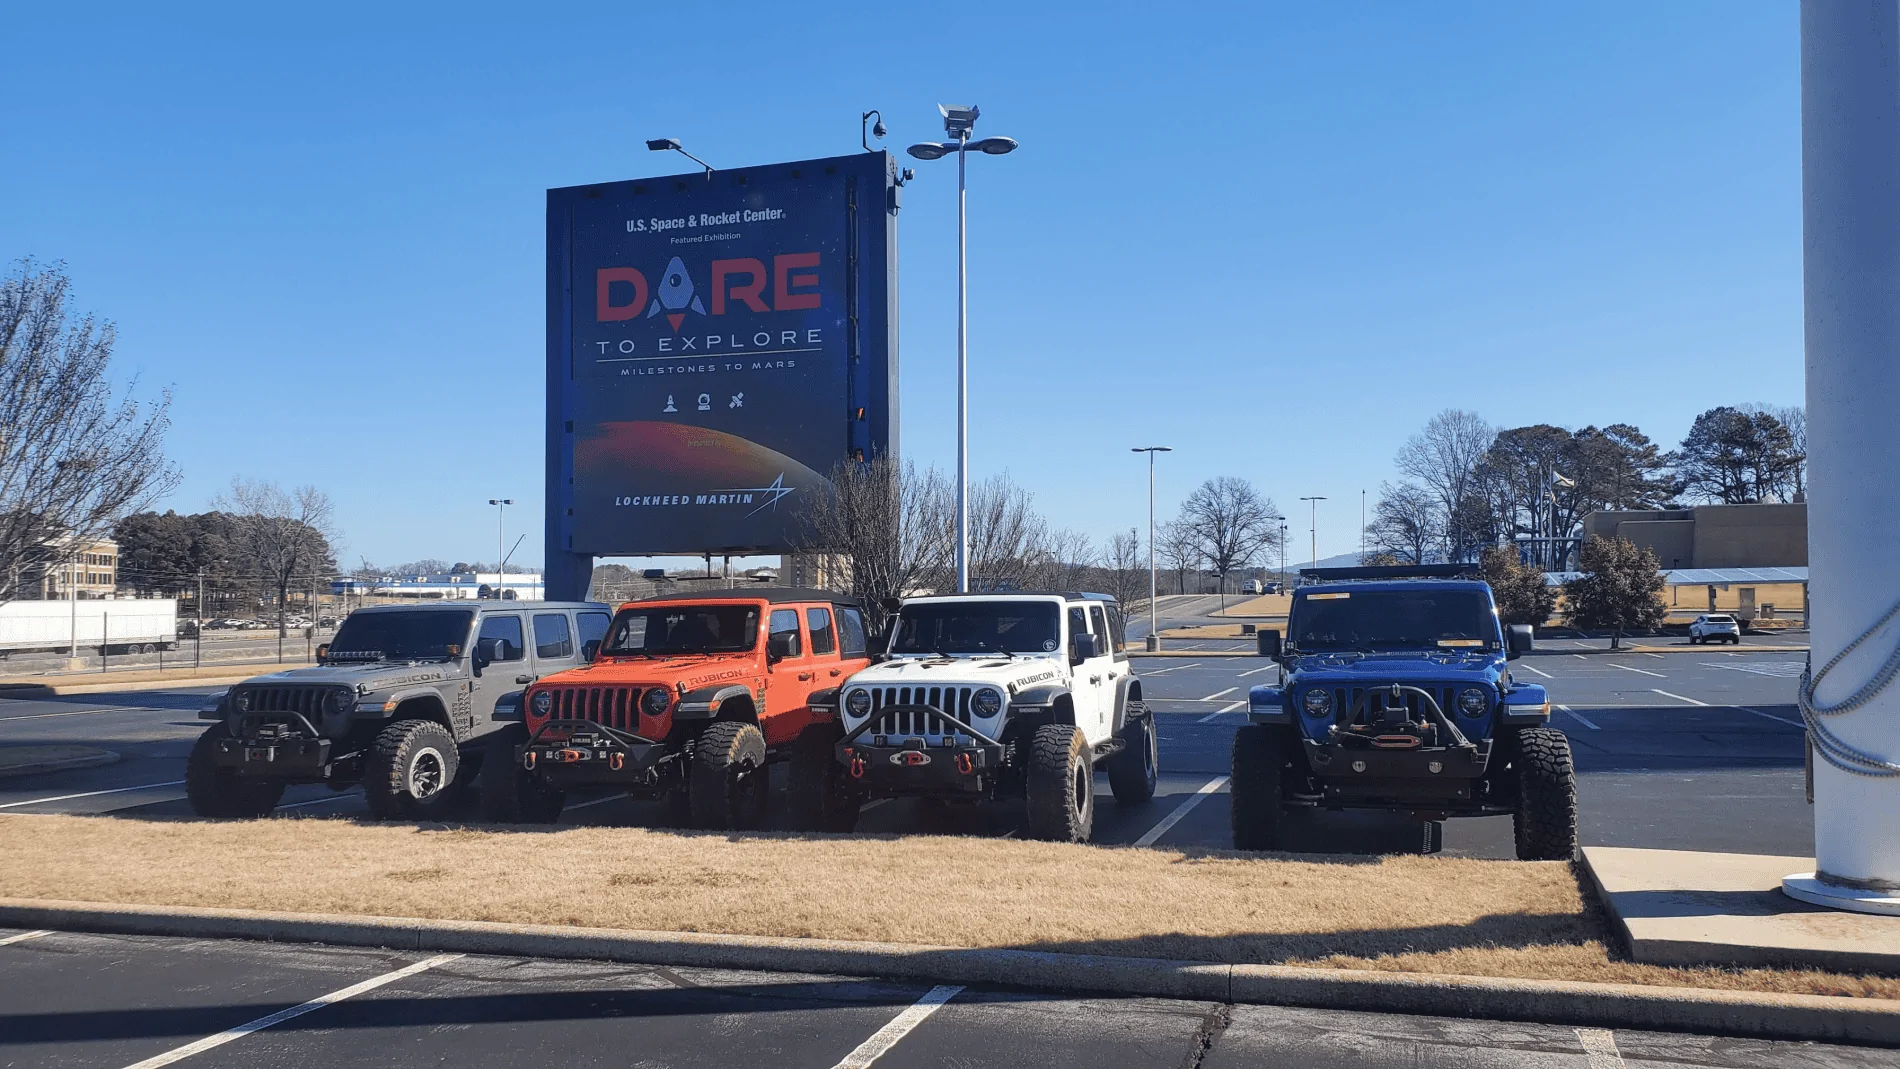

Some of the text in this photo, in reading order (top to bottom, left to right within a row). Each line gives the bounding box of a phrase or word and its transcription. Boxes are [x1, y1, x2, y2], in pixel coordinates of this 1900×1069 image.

[626, 220, 647, 232] U.S.
[650, 218, 685, 232] Space
[688, 215, 697, 227] &
[700, 211, 740, 226] Rocket
[670, 232, 741, 244] Featured Exhibition
[596, 329, 822, 354] TO EXPLORE
[620, 360, 795, 376] MILESTONES TO MARS
[615, 493, 753, 506] LOCKHEED MARTIN
[689, 669, 743, 685] RUBICON
[1016, 671, 1054, 686] RUBICON
